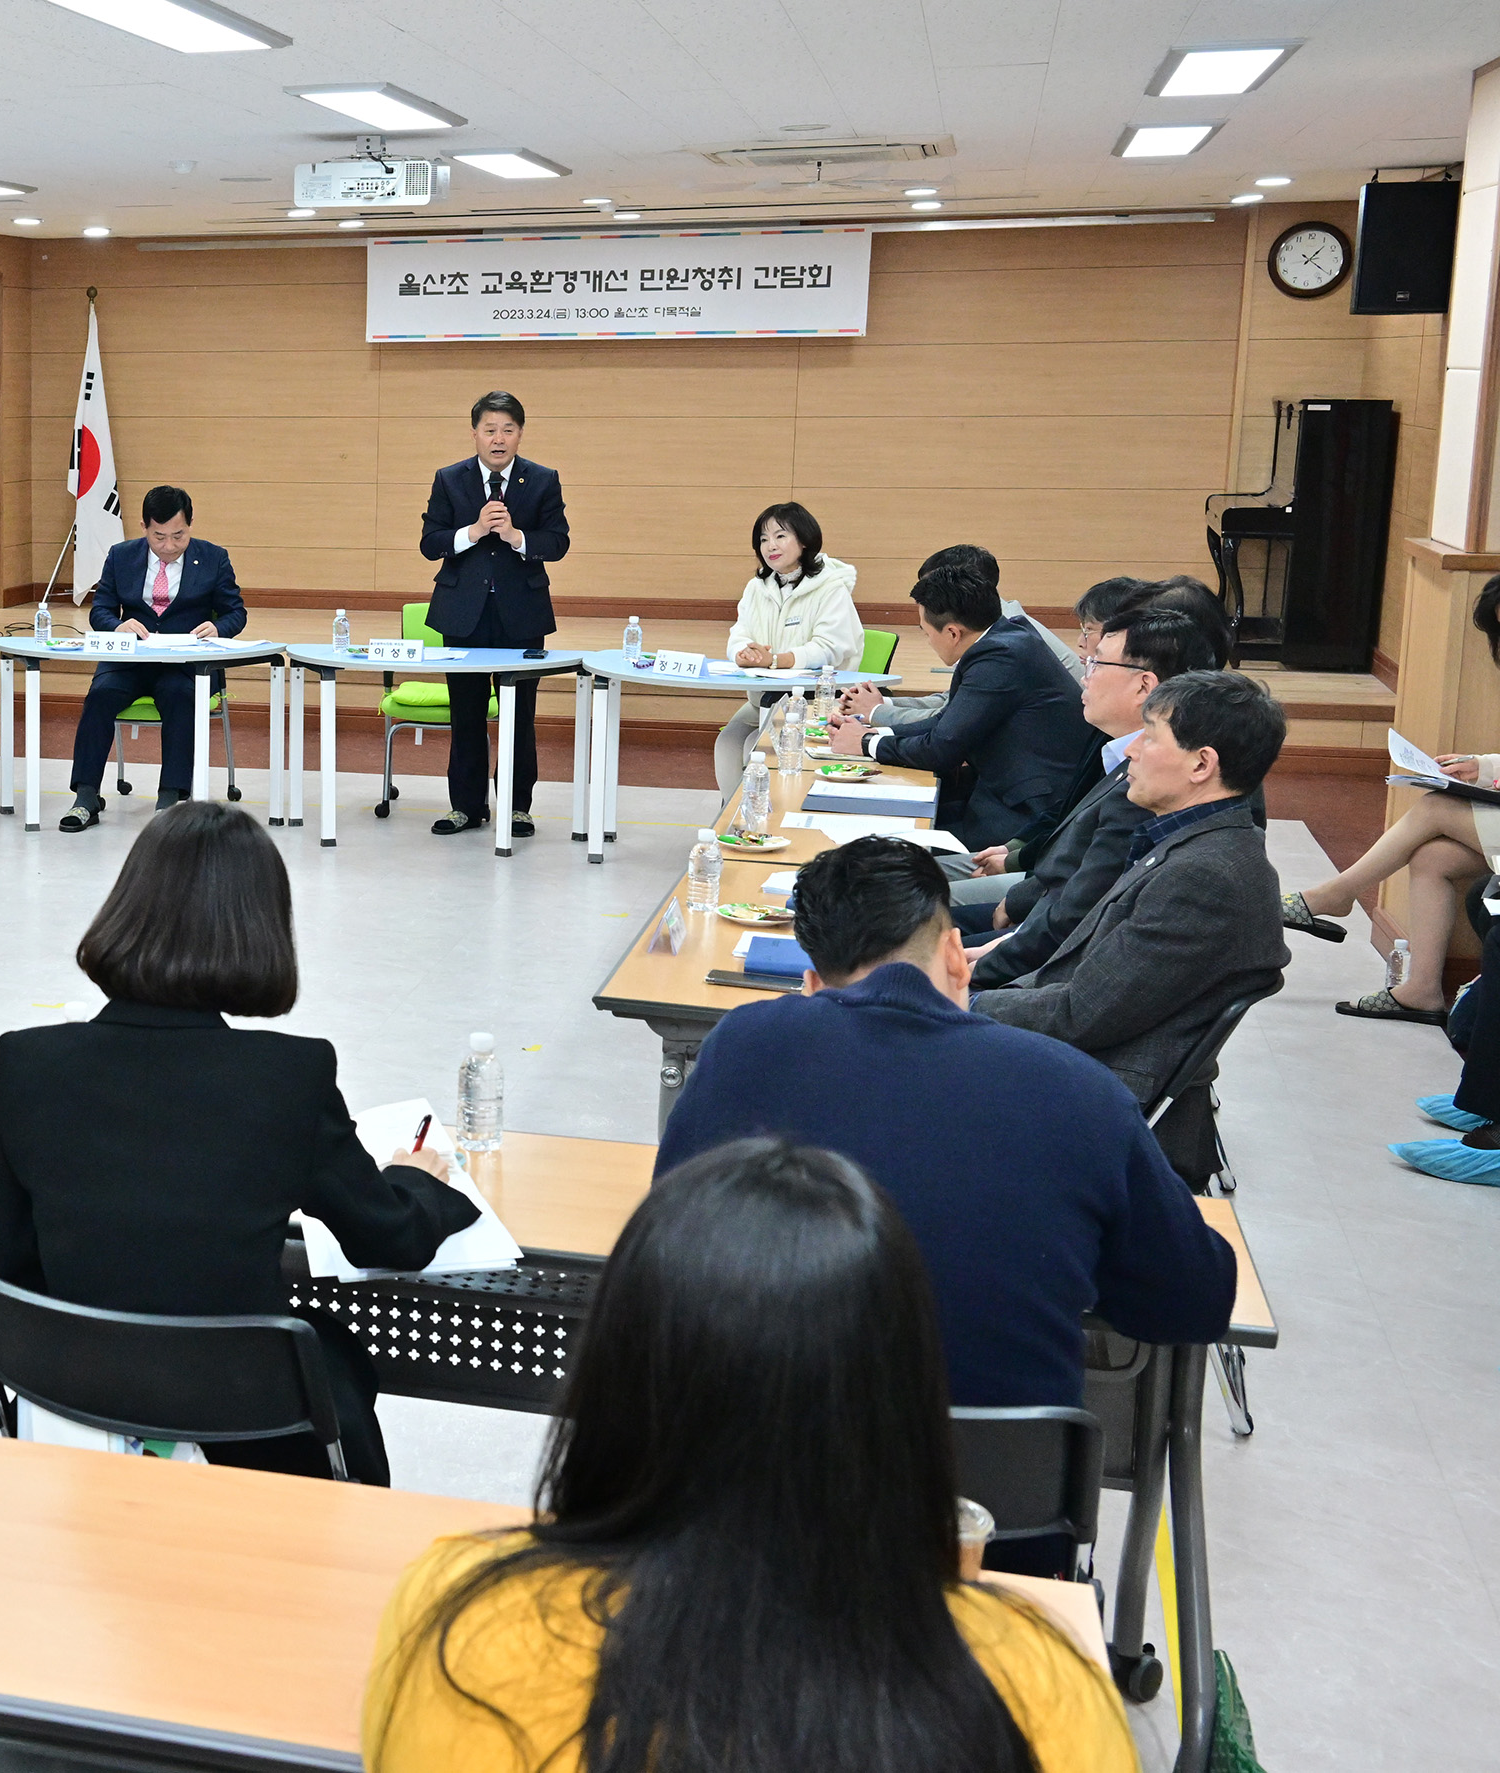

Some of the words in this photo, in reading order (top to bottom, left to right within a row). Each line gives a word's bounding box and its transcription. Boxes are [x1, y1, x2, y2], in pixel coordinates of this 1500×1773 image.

[398, 271, 469, 296] 울산초
[480, 269, 628, 294] 교육환경개선
[639, 265, 742, 292] 민원청취
[753, 263, 832, 290] 간담회
[492, 307, 571, 320] 2023.3.24.(금)
[575, 307, 610, 319] 13:00
[614, 306, 649, 319] 울산초
[654, 306, 702, 318] 다목적실
